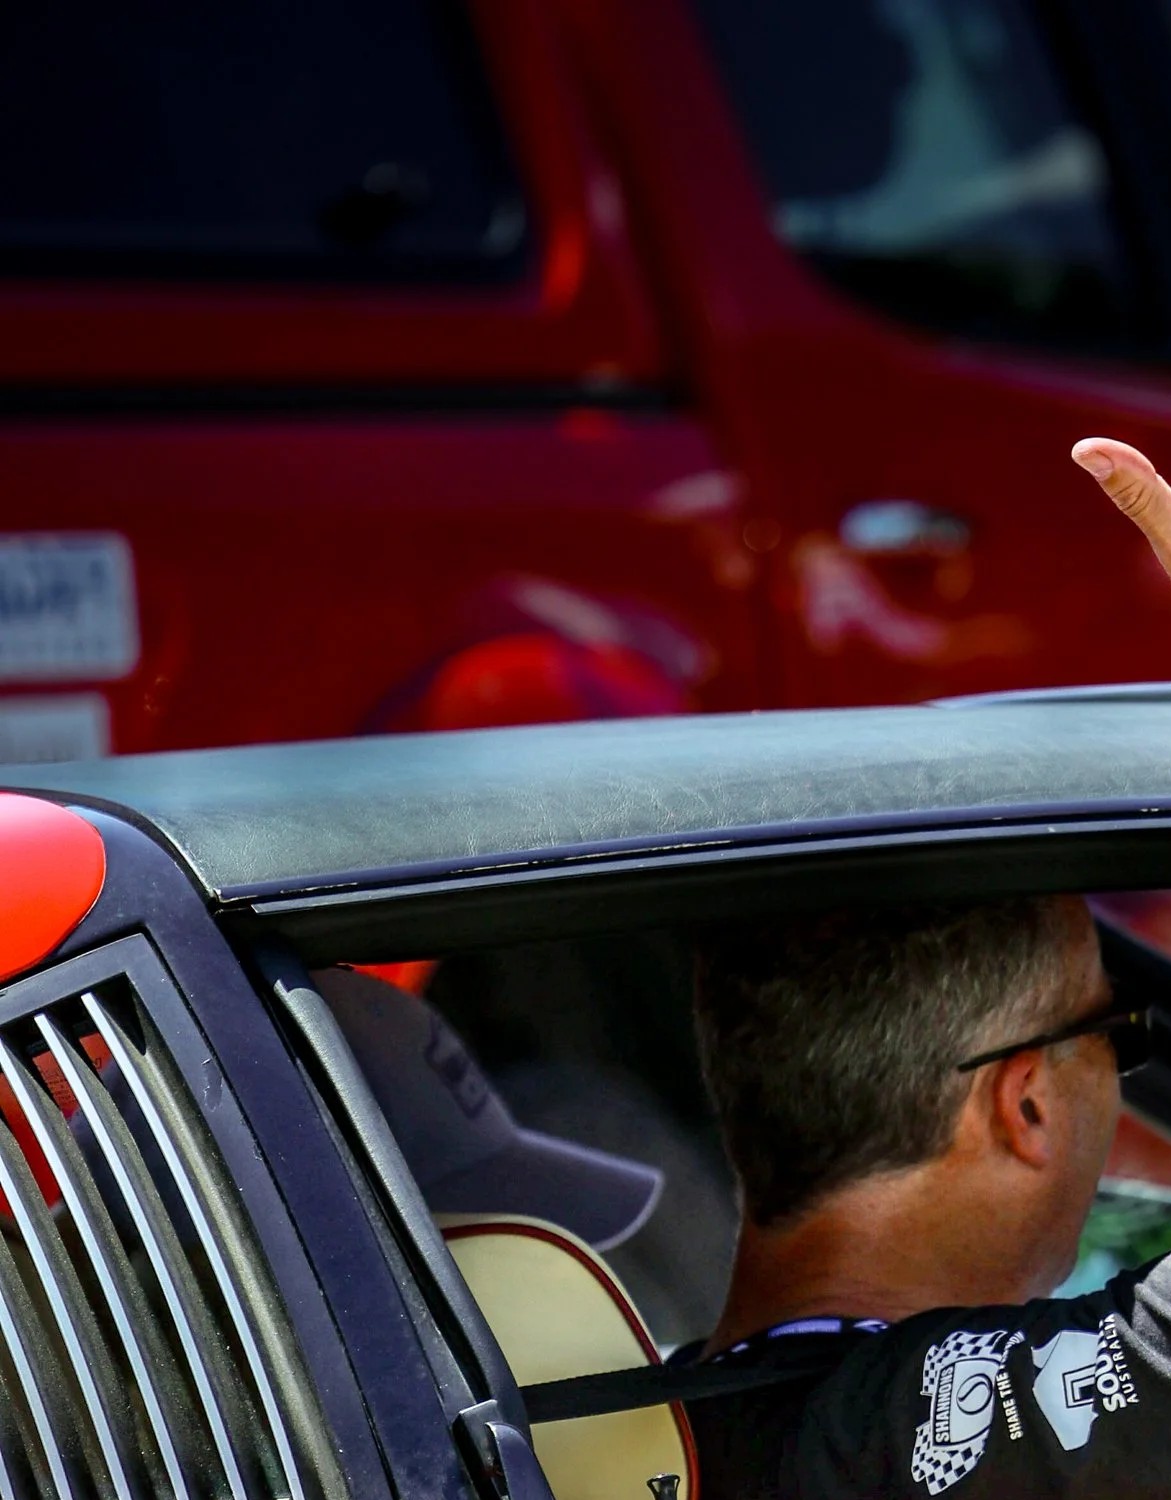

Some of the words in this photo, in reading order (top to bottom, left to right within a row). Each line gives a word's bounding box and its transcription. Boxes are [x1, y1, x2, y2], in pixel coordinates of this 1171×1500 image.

[996, 1371, 1013, 1399] THE
[1104, 1313, 1140, 1404] AUSTRALIA
[935, 1366, 954, 1443] SHANNONS
[1003, 1398, 1024, 1440] SHARE
